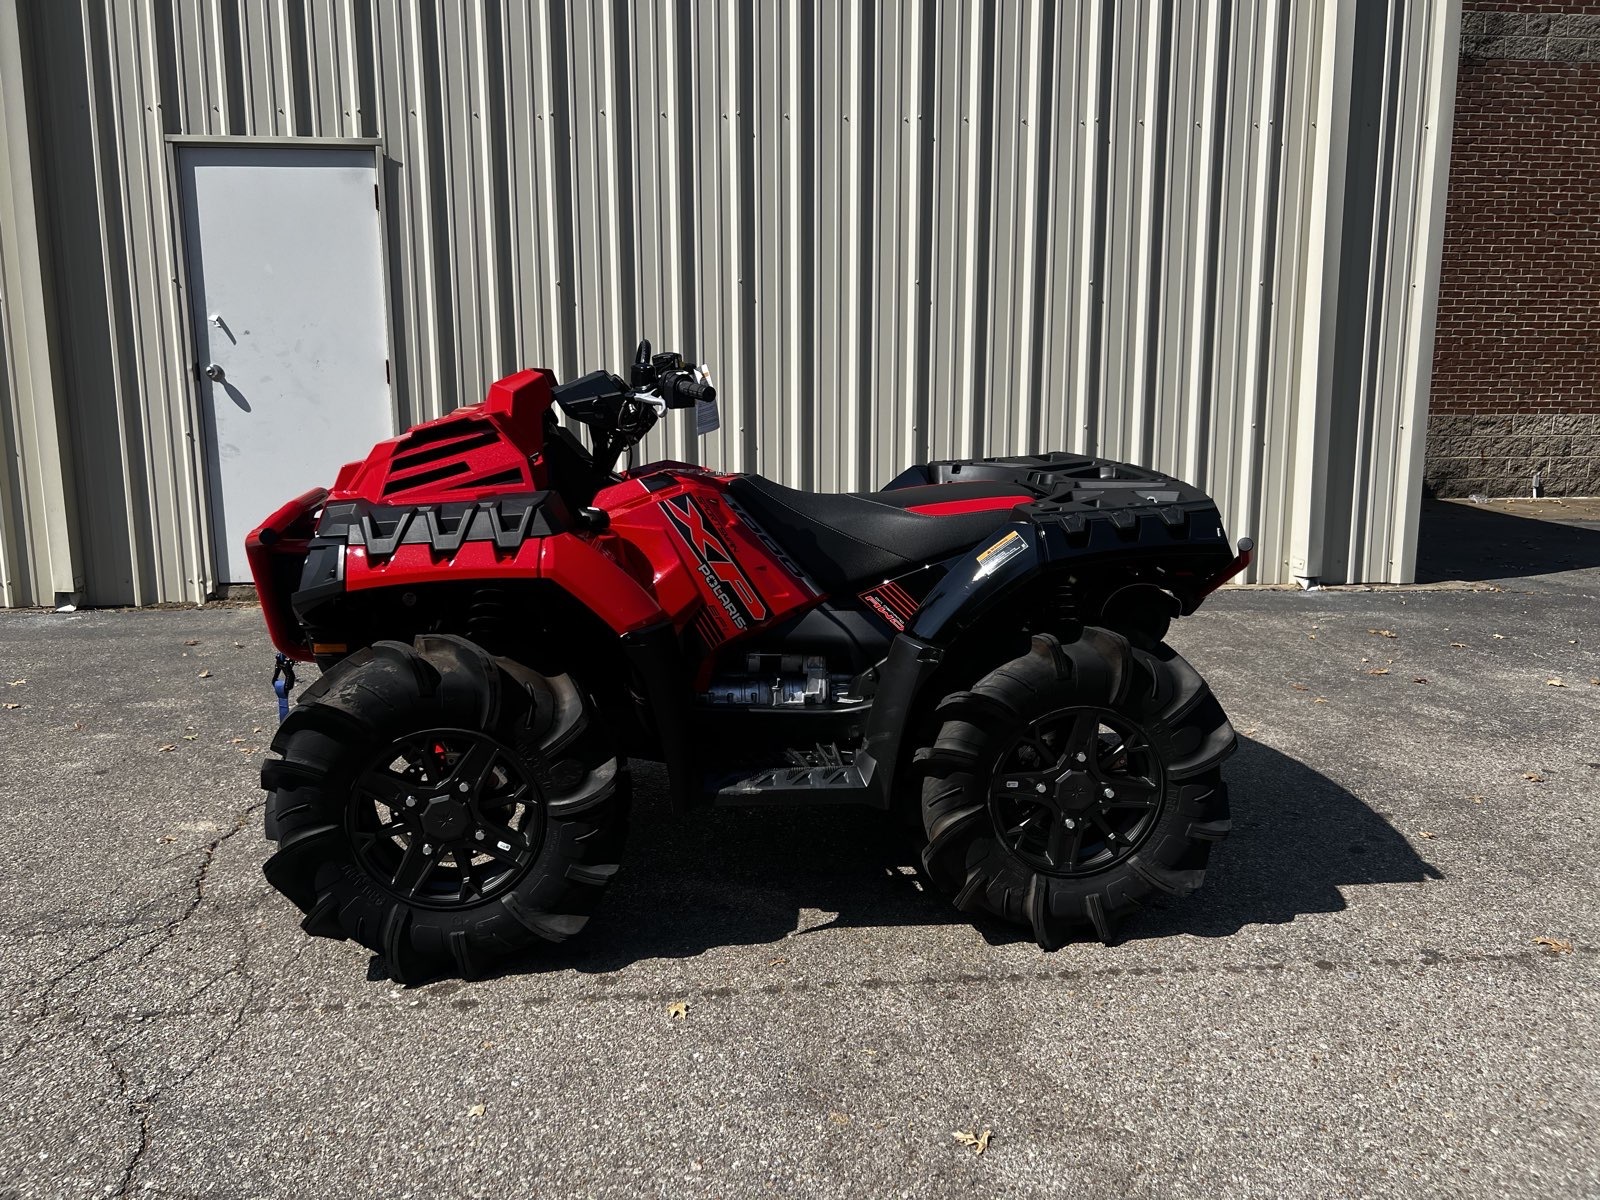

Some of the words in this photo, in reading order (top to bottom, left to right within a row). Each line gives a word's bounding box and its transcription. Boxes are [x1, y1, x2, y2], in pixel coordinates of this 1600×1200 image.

[663, 496, 766, 620] XP
[698, 563, 747, 630] POLARIS
[864, 595, 905, 631] AWD
